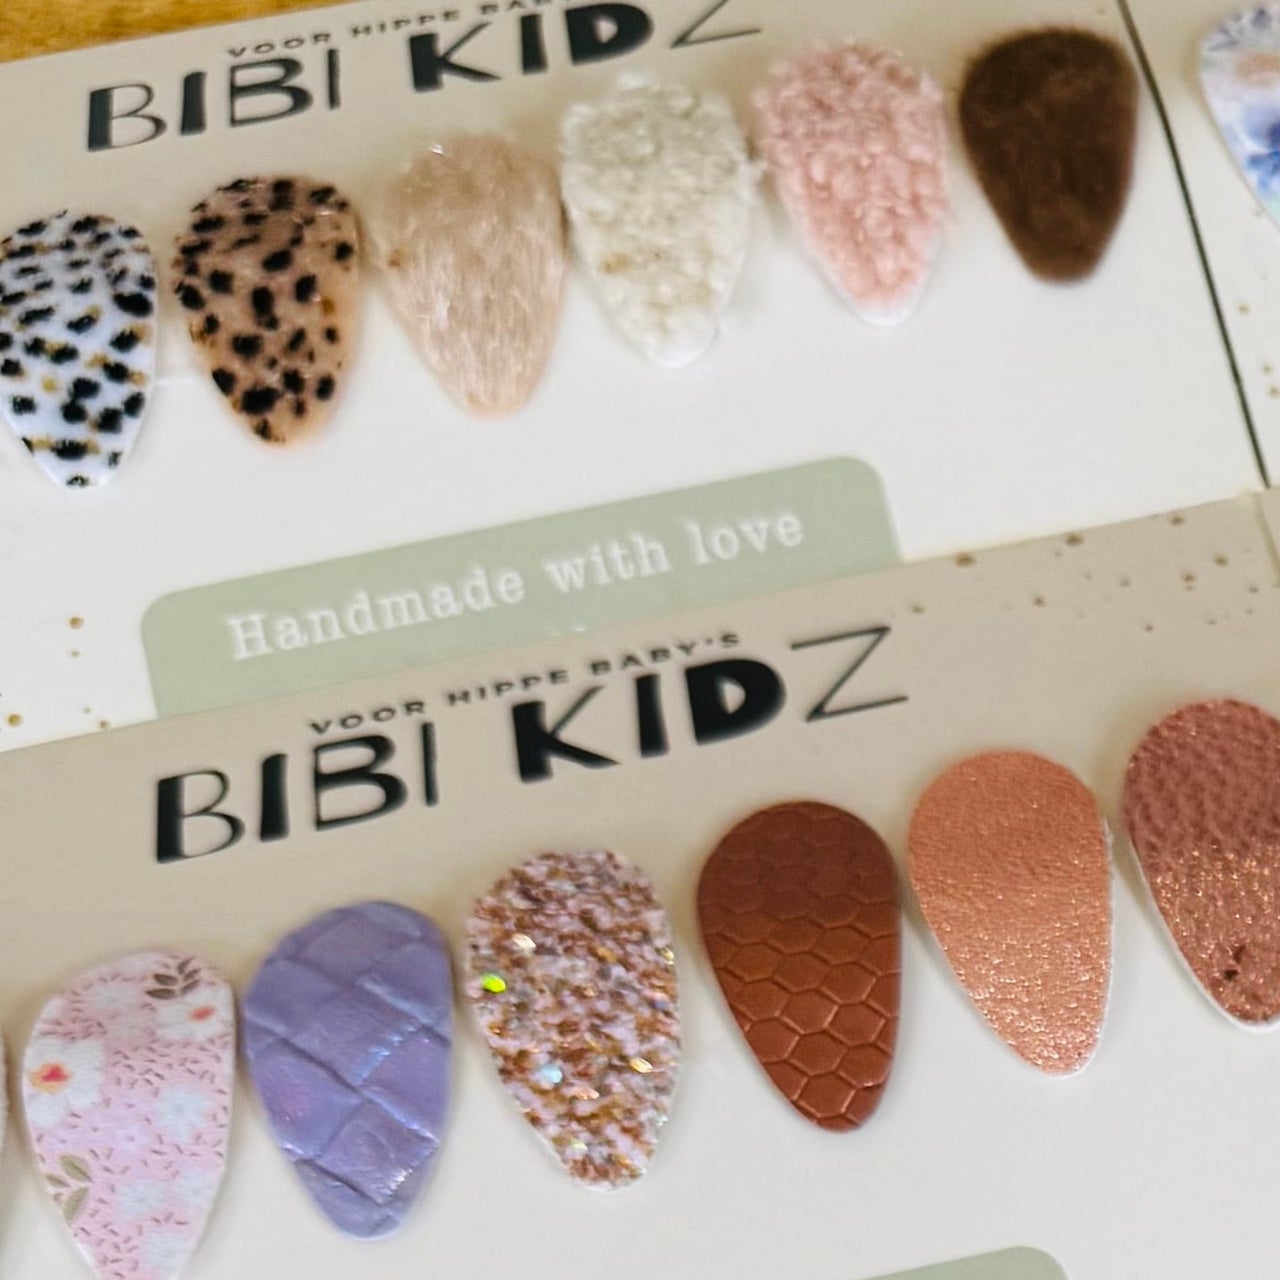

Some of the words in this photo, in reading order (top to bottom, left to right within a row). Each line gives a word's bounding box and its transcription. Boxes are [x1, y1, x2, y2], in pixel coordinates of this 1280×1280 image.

[87, 49, 340, 152] BIBI
[225, 564, 526, 662] Handmade
[543, 530, 673, 596] with
[686, 507, 805, 565] love
[155, 722, 438, 864] BIBI
[511, 626, 909, 784] KIDZ
[311, 698, 425, 736] VOOR
[447, 669, 567, 708] HIPPE
[591, 633, 741, 676] BABY'S
